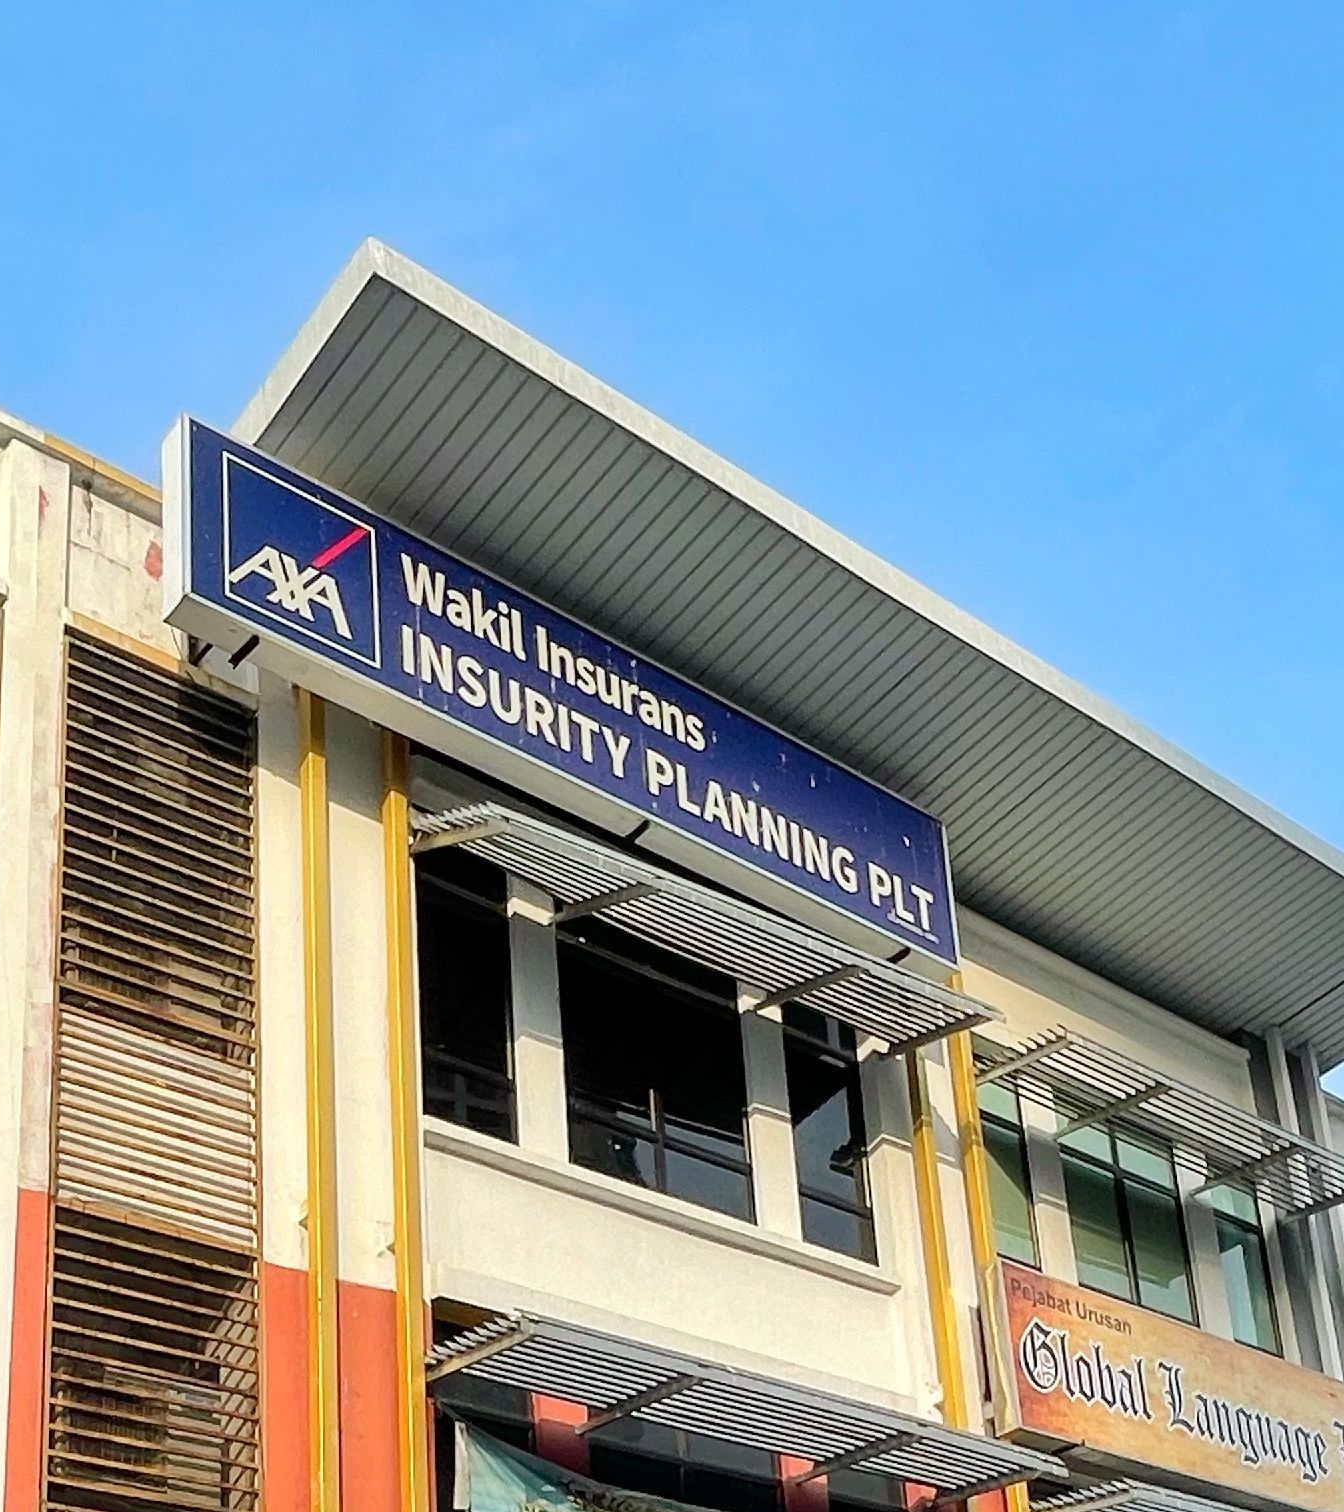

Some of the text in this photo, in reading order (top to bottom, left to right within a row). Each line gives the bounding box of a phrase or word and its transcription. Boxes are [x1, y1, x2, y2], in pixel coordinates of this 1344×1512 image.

[229, 544, 354, 641] AXA
[398, 553, 707, 752] Wakil Insurans
[401, 625, 936, 933] INSURITY PLANNING PLT
[1010, 1277, 1134, 1335] Pejabat Urusan
[1021, 1320, 1153, 1420] Global
[1158, 1362, 1329, 1483] Language
